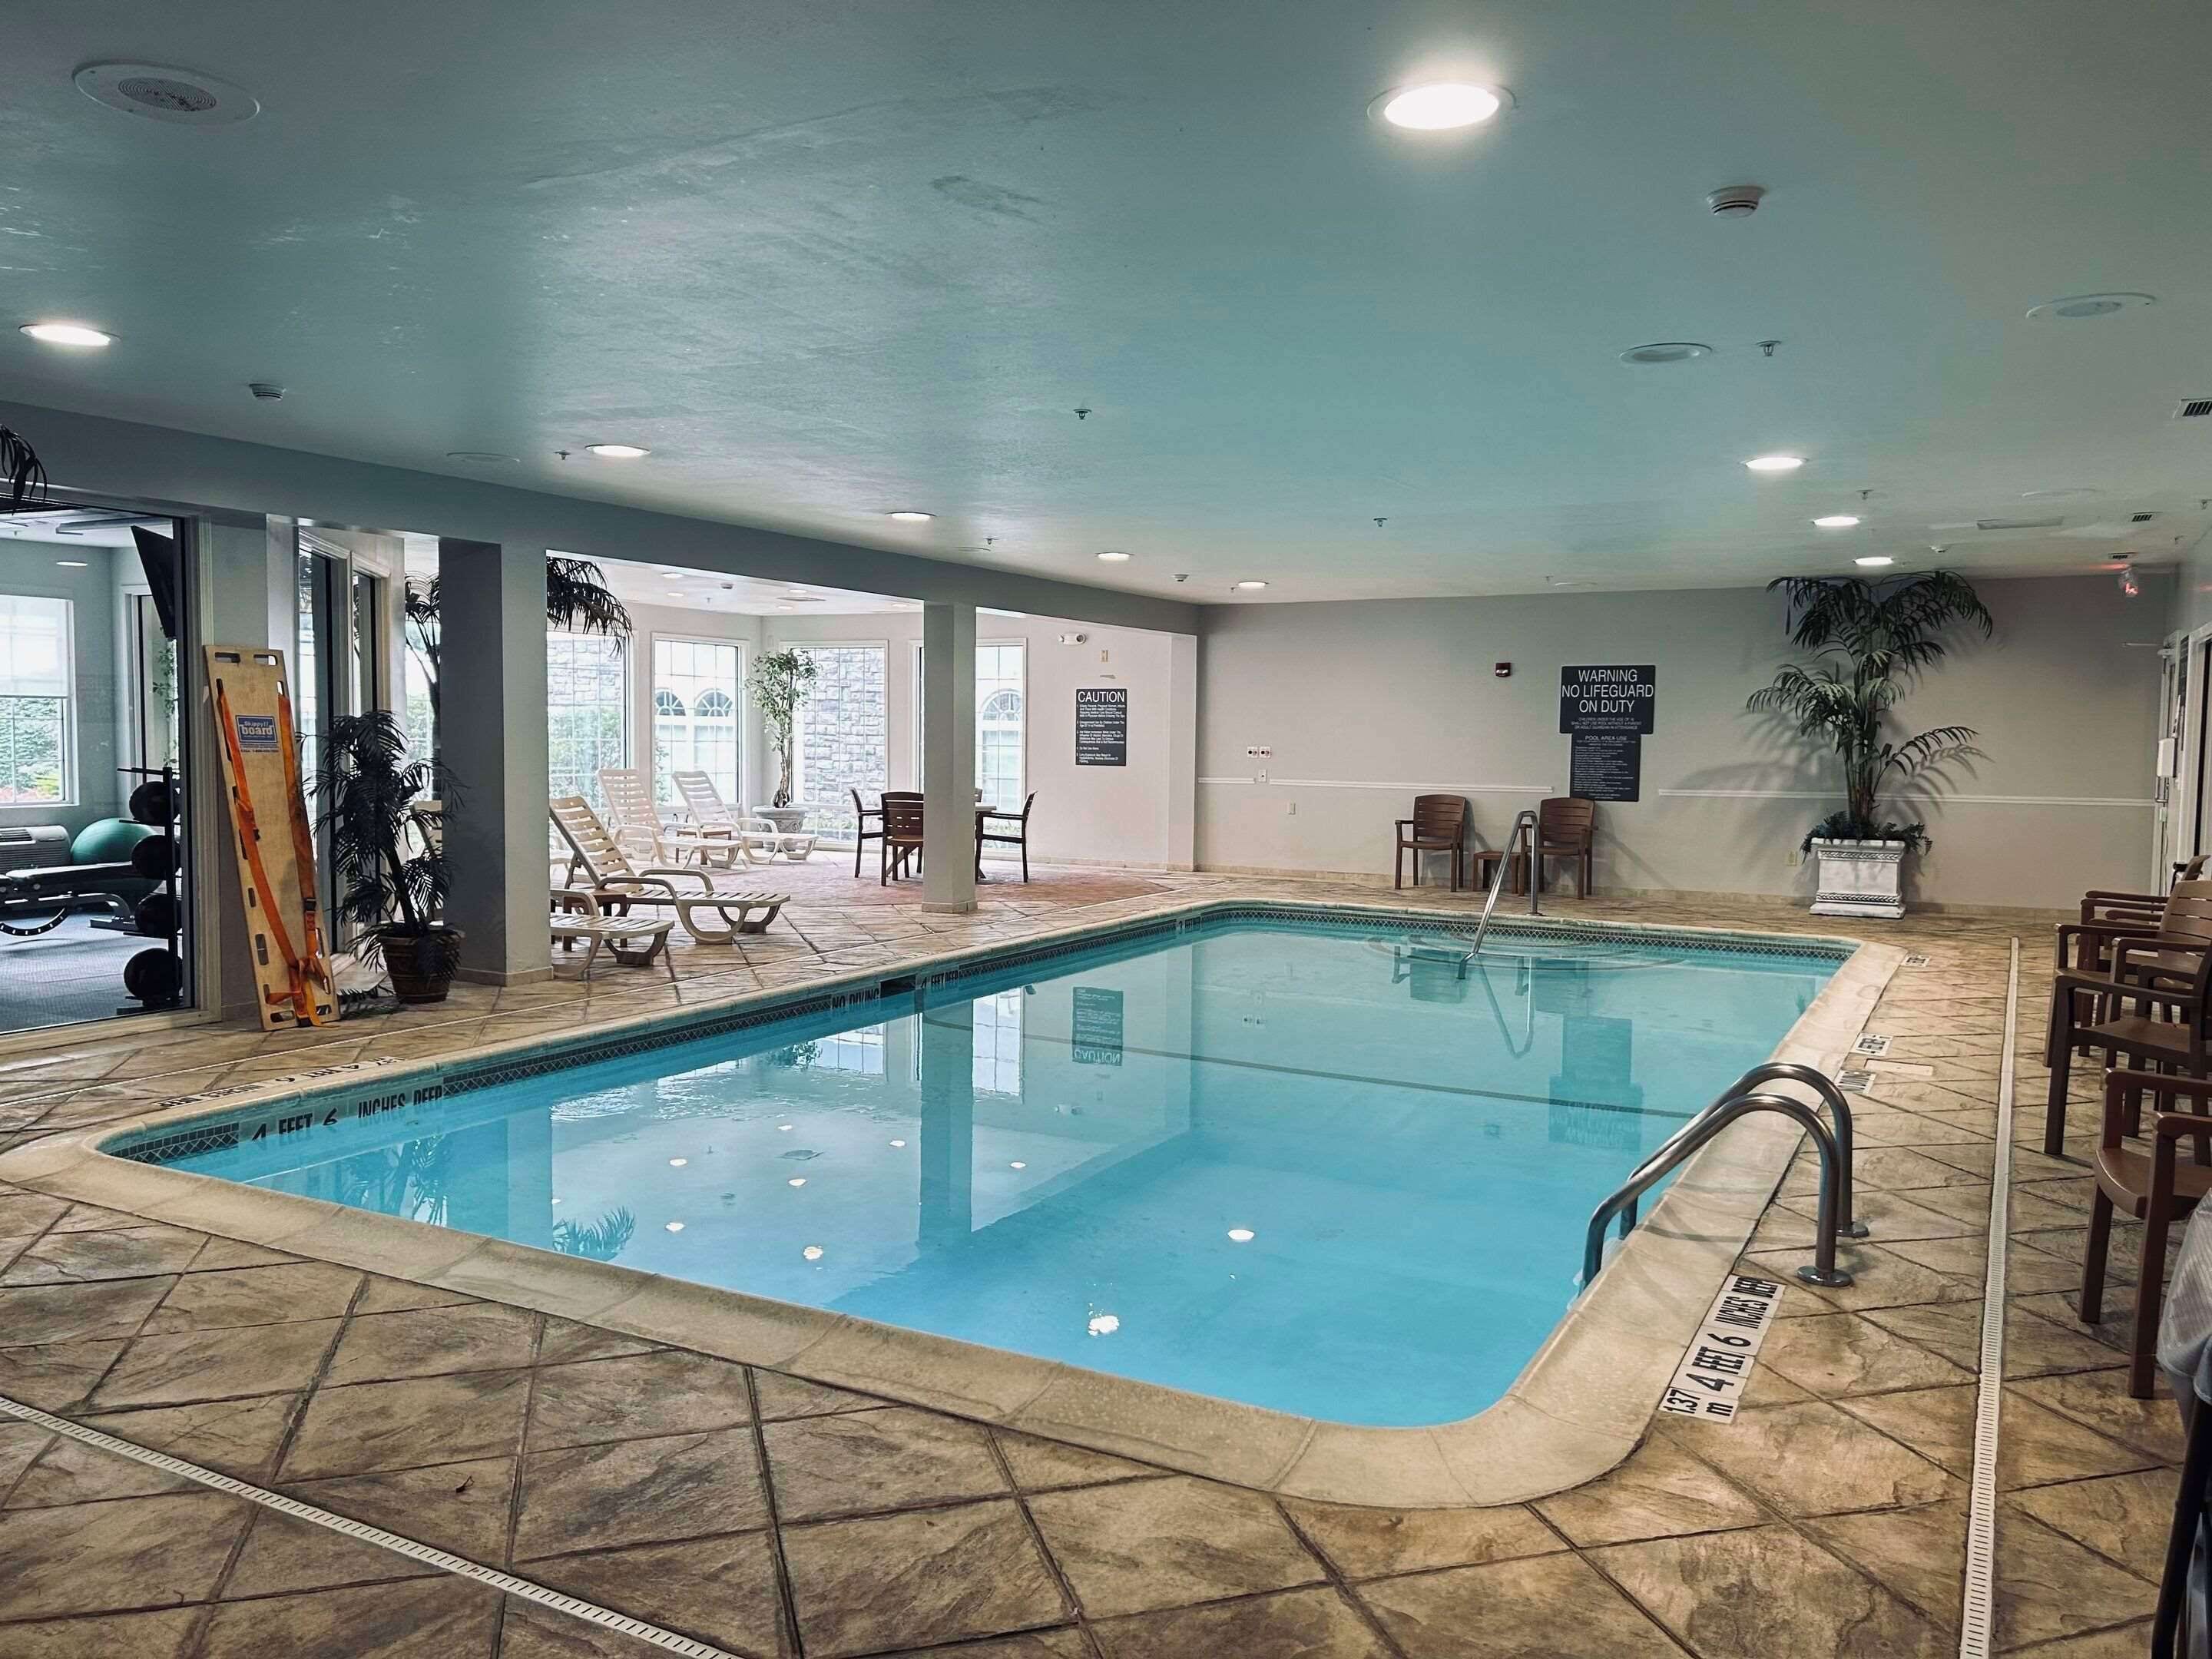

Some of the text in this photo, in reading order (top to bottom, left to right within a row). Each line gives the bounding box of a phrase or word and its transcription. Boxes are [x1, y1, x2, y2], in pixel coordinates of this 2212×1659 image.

[1578, 669, 1637, 682] WARNING
[1078, 691, 1124, 702] CAUTION
[1561, 684, 1654, 697] NO LIFEGUARD
[1579, 700, 1634, 713] ON DUTY
[240, 724, 273, 735] board
[832, 995, 845, 1008] NO
[279, 1113, 313, 1134] FEET
[322, 1108, 338, 1126] 6
[357, 1093, 406, 1118] INCHES
[413, 1084, 443, 1106] DEEP
[1686, 1276, 1779, 1392] 4 FEET 6 INCHES DEEP
[1663, 1389, 1700, 1414] 1.37
[1706, 1402, 1734, 1417] m
